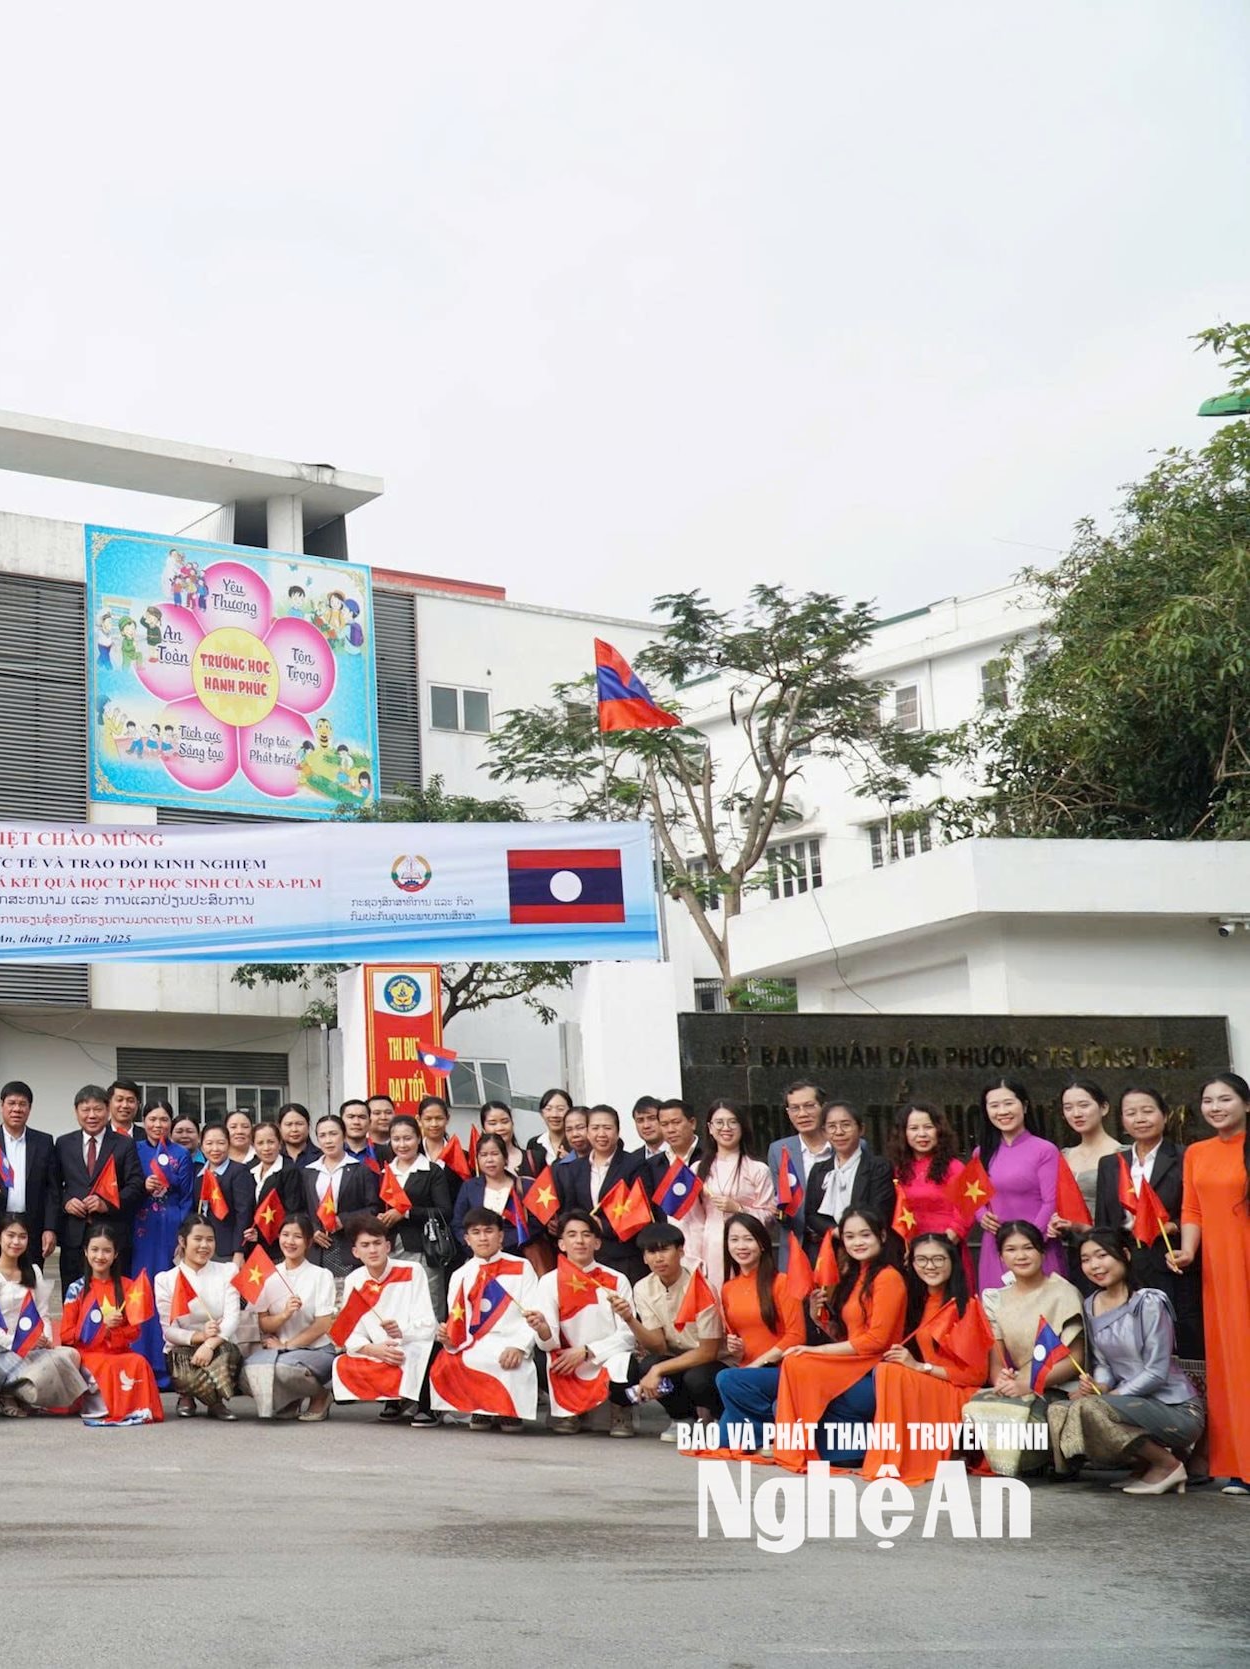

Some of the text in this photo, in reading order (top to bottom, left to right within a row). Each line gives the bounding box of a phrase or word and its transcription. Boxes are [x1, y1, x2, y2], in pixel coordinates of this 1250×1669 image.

[222, 578, 244, 594] Yêu
[212, 593, 257, 616] Thương
[163, 625, 183, 641] An
[158, 645, 189, 663] Toàn
[200, 653, 245, 671] TRƯỜNG
[291, 647, 313, 663] Tôn
[286, 664, 319, 685] Trọng
[238, 679, 267, 696] PHÚC
[179, 725, 222, 744] Tích cực
[276, 736, 291, 747] tác
[179, 742, 224, 763] Sáng tạo
[249, 749, 297, 765] Phát triển
[37, 829, 95, 847] CHÀO
[102, 830, 164, 847] MỪNG
[16, 856, 38, 869] TẾ
[42, 856, 65, 869] VÀ
[69, 858, 114, 869] TRAO
[154, 859, 194, 870] KINH
[200, 858, 267, 872] NGHIỆM
[11, 876, 40, 888] KẾT
[44, 876, 77, 890] QUẢ
[81, 878, 114, 891] HỌC
[117, 878, 146, 890] TẬP
[149, 878, 181, 891] HỌC
[185, 878, 220, 889] SINH
[223, 876, 255, 889] CỦA
[257, 878, 322, 889] SEA-PLM
[196, 915, 254, 925] SEA-PLM
[19, 934, 53, 945] tháng
[57, 934, 71, 944] 12
[73, 934, 100, 944] năm
[103, 934, 132, 944] 2025
[388, 1037, 420, 1061] THI ĐU
[761, 1045, 808, 1067] BAN
[817, 1039, 882, 1067] NHÂN
[889, 1039, 938, 1067] DÂN
[388, 1069, 425, 1107] DẠY TỐT
